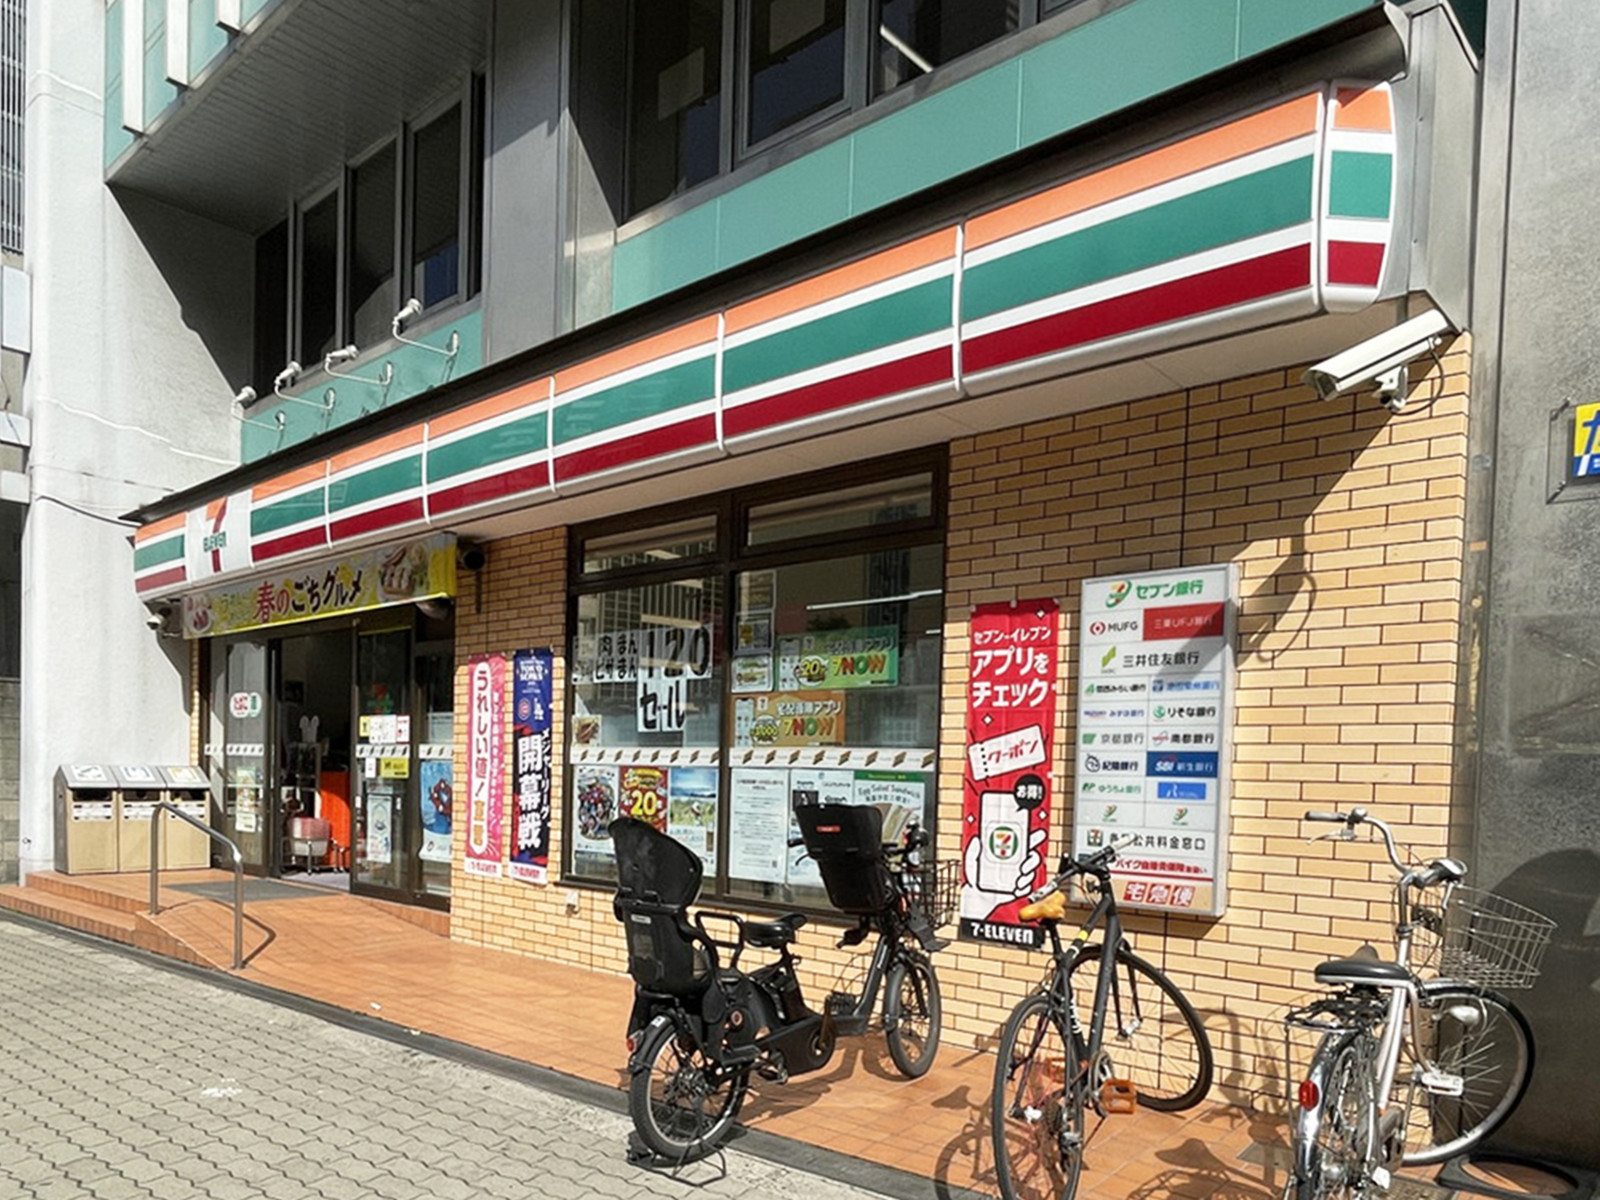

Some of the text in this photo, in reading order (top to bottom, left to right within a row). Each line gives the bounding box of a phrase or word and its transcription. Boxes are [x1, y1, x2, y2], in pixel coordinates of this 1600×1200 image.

[253, 566, 362, 623] 春のごちグルメ
[1136, 579, 1204, 599] セブン銀行
[1108, 621, 1138, 632] MUFG
[647, 626, 711, 679] 120
[972, 645, 1049, 678] アプリを
[1123, 651, 1200, 668] 三井住友銀行
[972, 678, 1049, 708] チェック
[1168, 706, 1216, 718] りそな銀行
[1101, 733, 1144, 744] 京都銀行
[988, 739, 1039, 764] クーポン
[518, 734, 542, 850] 開幕戦
[630, 790, 657, 816] 20
[1110, 833, 1206, 850] 各公共料金窓口
[1124, 882, 1195, 907] 宅急便
